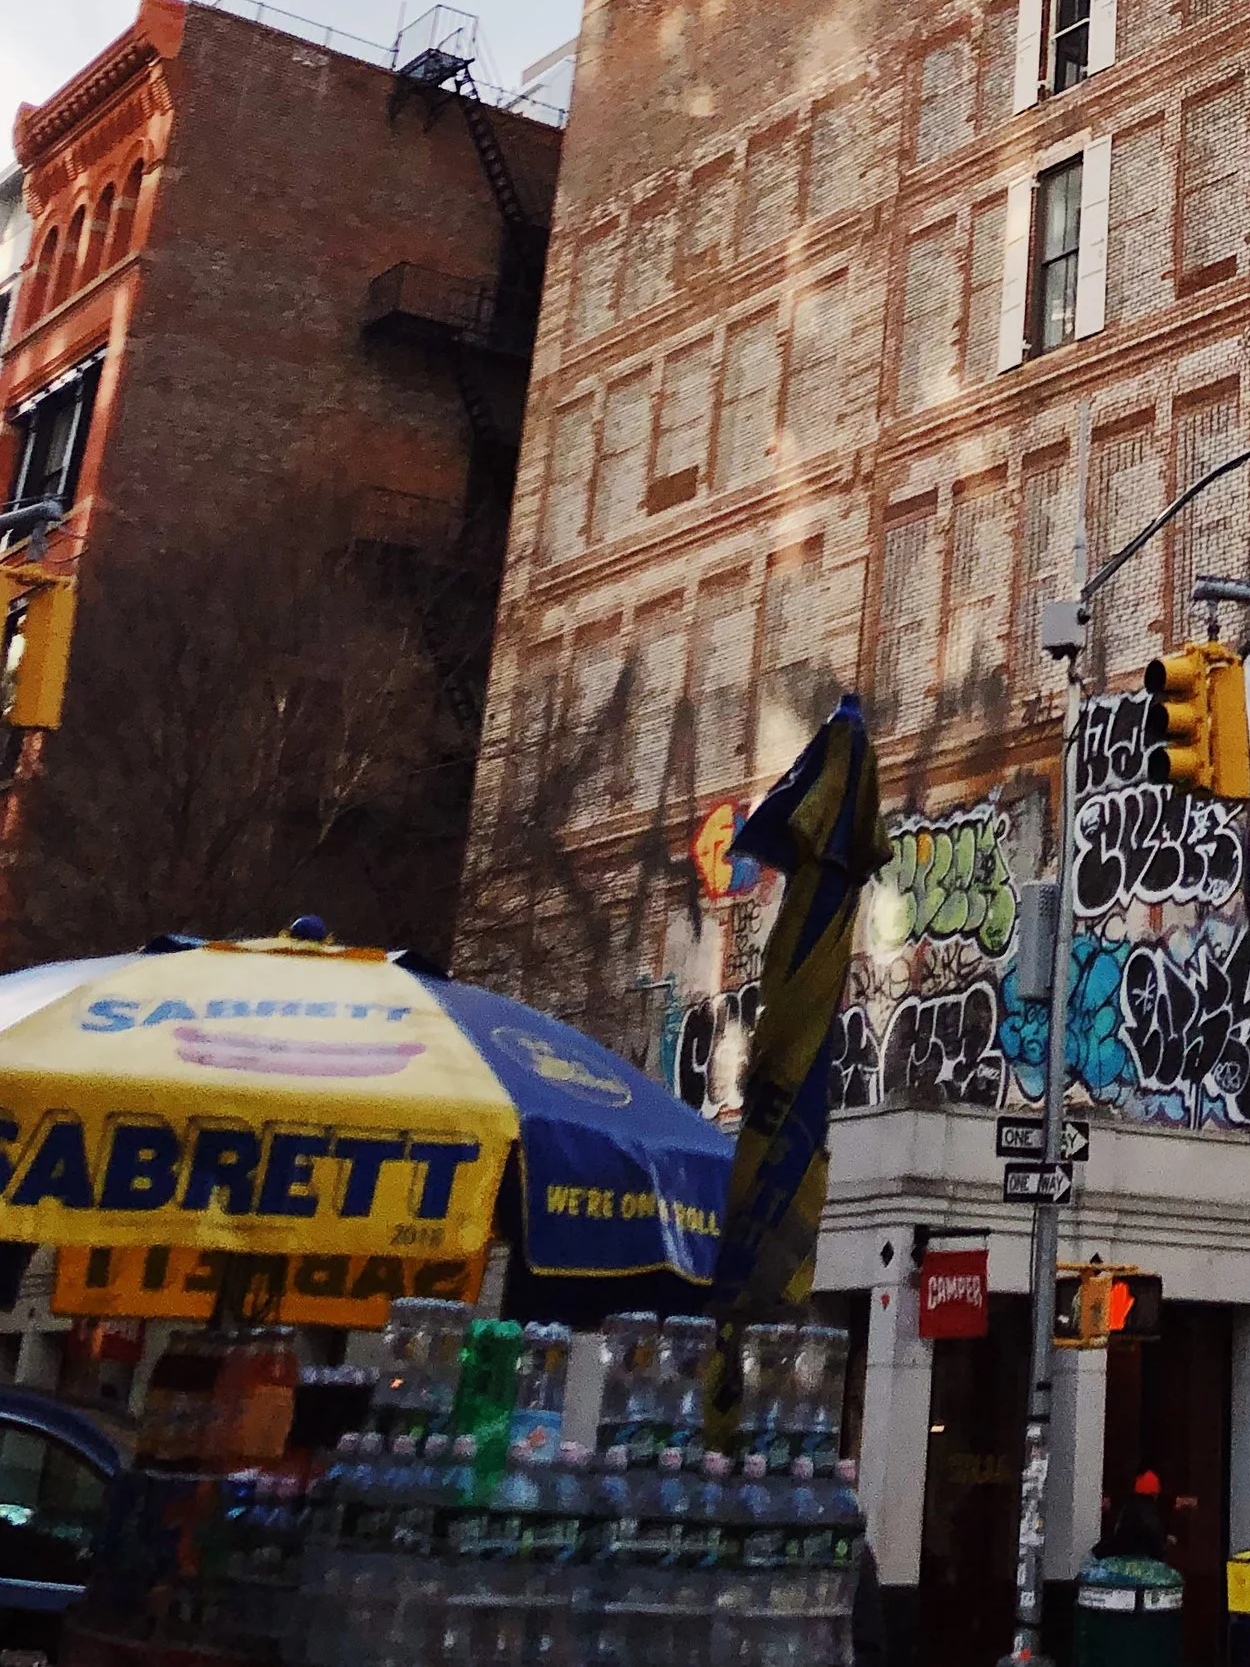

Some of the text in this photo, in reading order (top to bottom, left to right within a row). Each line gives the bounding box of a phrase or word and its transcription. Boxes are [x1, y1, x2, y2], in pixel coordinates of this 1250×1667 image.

[79, 998, 412, 1034] SABRETT
[1005, 1129, 1033, 1146] ONE
[1009, 1174, 1064, 1194] ONE WAY
[927, 1275, 983, 1310] CAMPER
